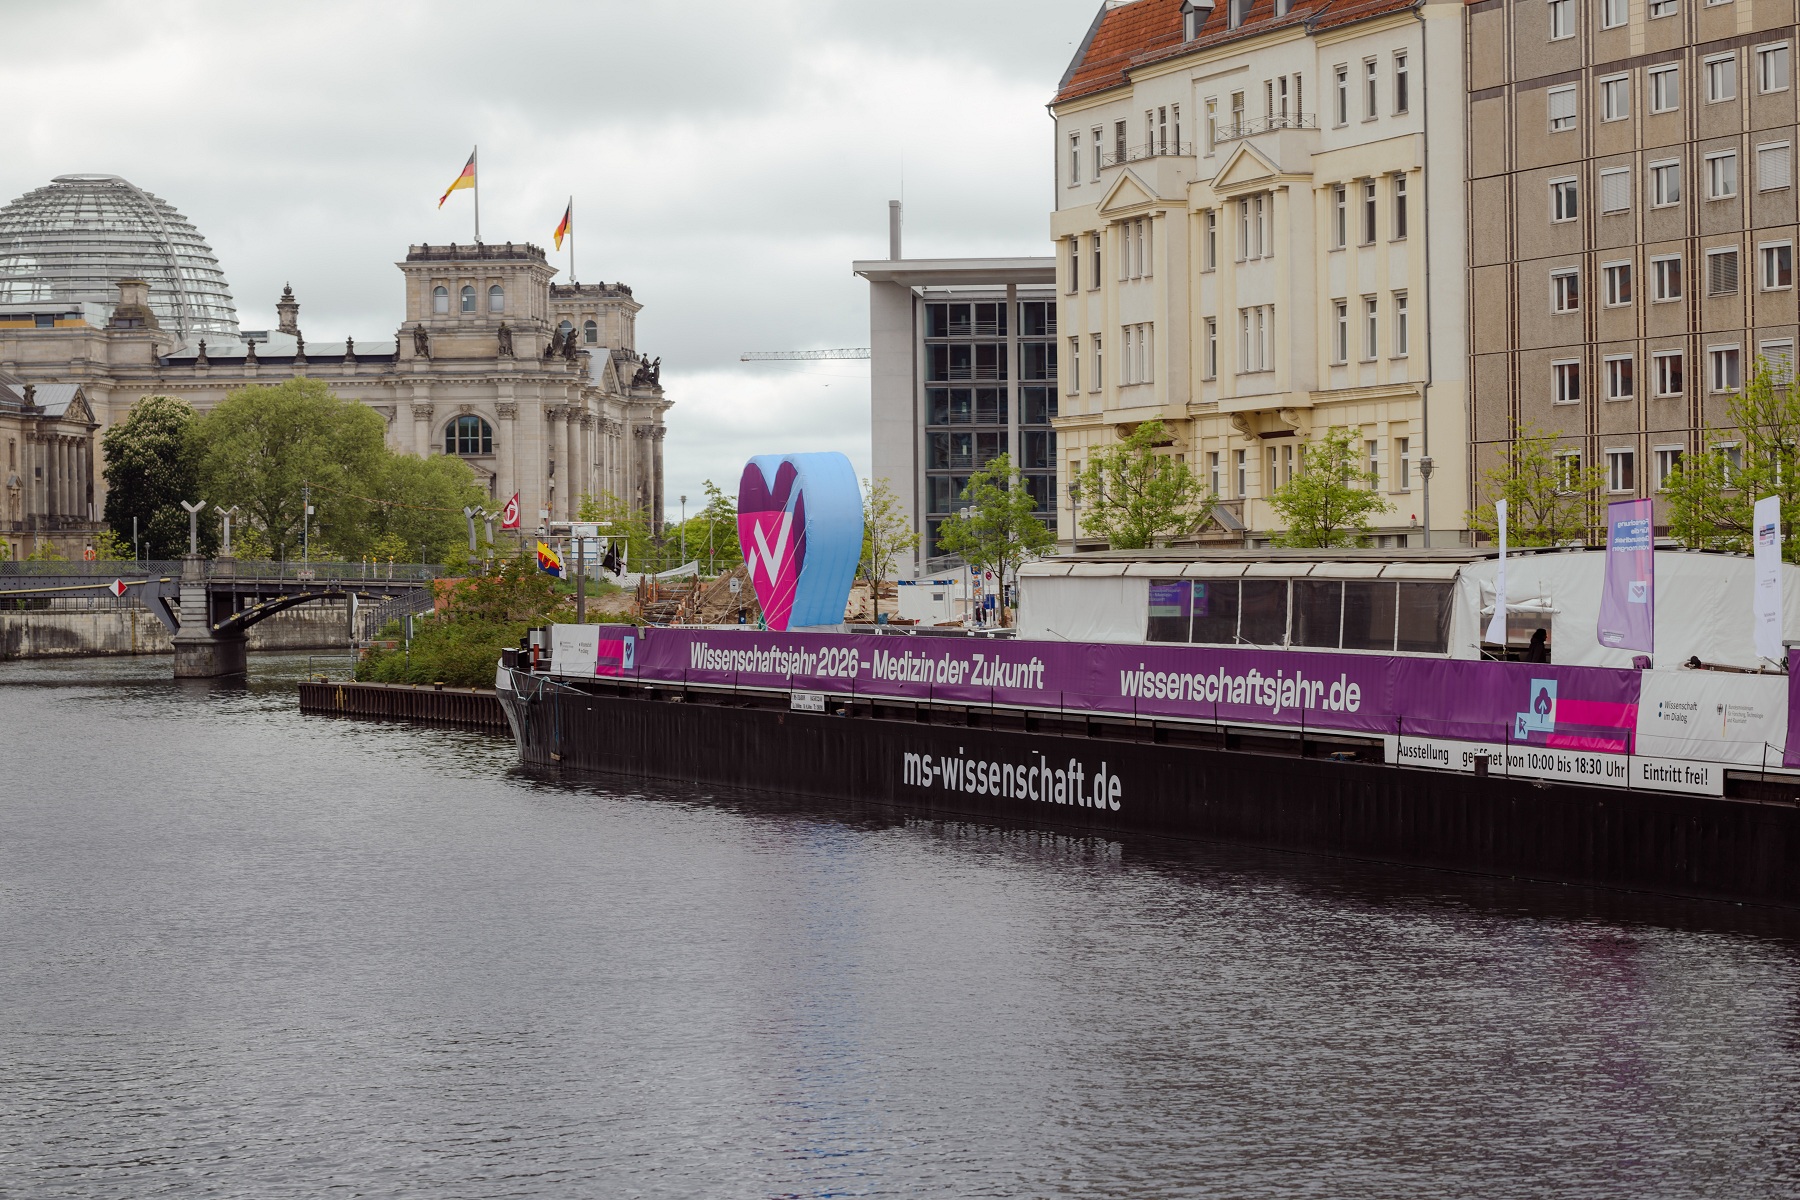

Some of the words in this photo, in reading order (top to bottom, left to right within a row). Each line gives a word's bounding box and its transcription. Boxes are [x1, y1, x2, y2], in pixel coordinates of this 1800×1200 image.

[690, 641, 817, 681] Wissenschaftsjahr
[816, 646, 859, 679] 2026
[872, 649, 935, 683] Medizin
[936, 652, 970, 685] der
[970, 653, 1045, 690] Zukunft
[1120, 662, 1361, 715] wissenschaftsjahr.de
[1664, 700, 1698, 711] Wissenschaft
[1663, 712, 1671, 721] im
[1671, 713, 1688, 724] Dialog
[1398, 741, 1449, 765] Ausstellung
[1462, 748, 1503, 768] genet
[1507, 755, 1524, 768] von
[1528, 753, 1554, 771] 10:00
[1557, 755, 1572, 773] bis
[1574, 757, 1602, 775] 18:30
[1606, 760, 1625, 778] Uhr
[1643, 763, 1682, 783] Eintritt
[1685, 767, 1708, 786] frei!
[903, 746, 1122, 811] ms-wissenschaft.de
